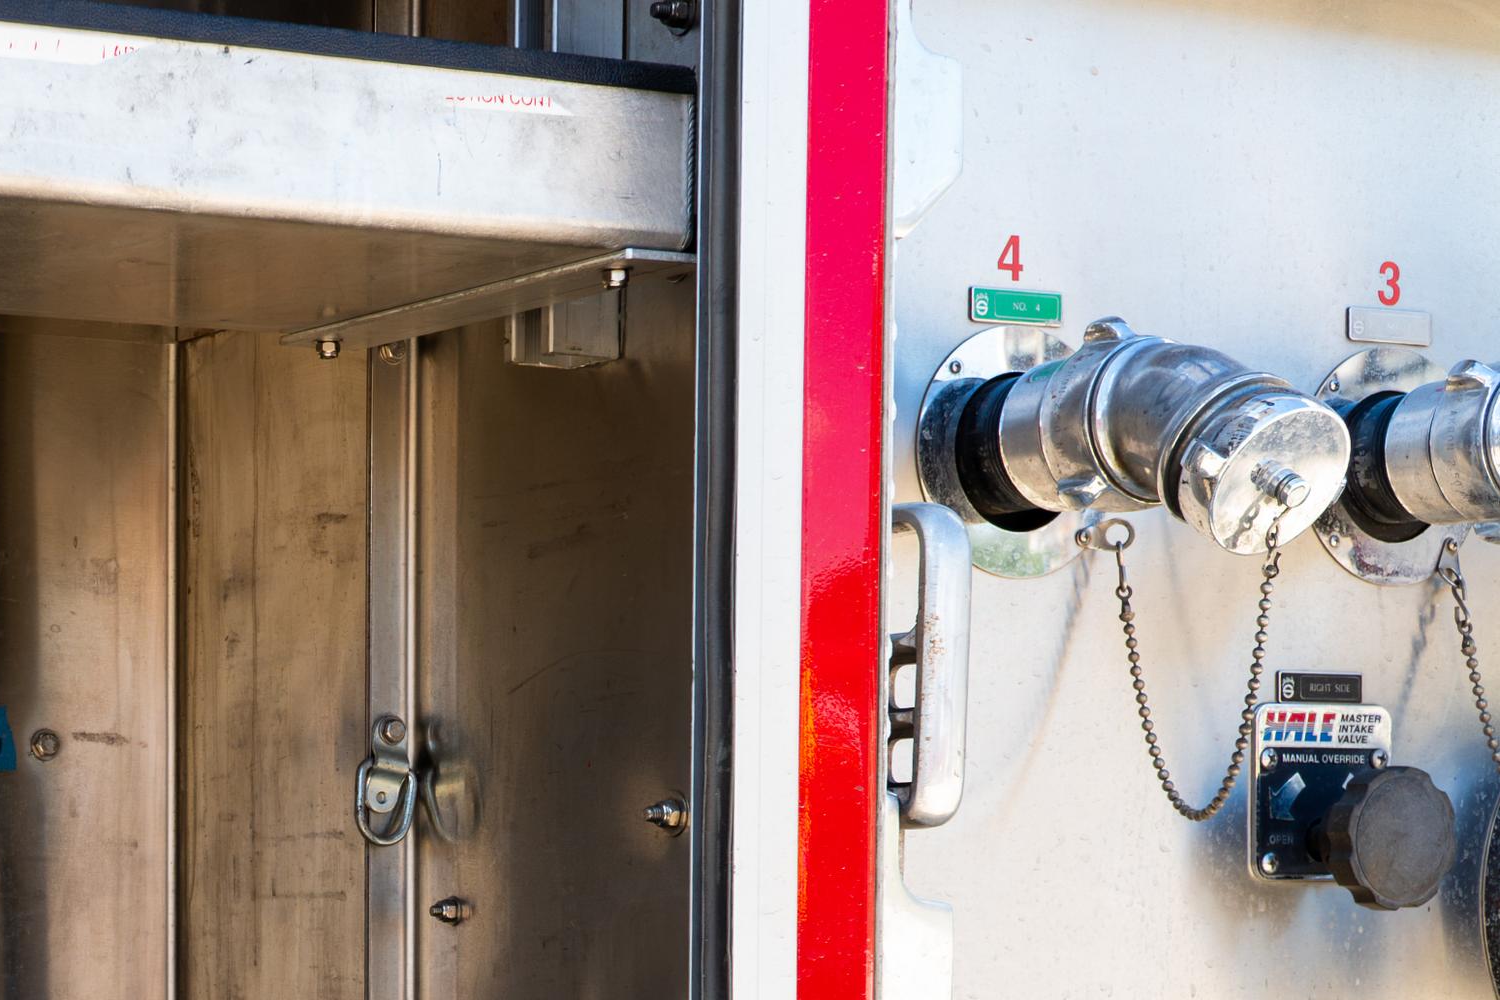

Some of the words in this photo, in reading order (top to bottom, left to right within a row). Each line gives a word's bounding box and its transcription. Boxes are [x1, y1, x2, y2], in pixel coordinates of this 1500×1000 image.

[997, 235, 1023, 281] 4
[1378, 261, 1400, 306] 3
[1035, 303, 1041, 312] 4
[1341, 714, 1381, 724] MASTER
[1263, 712, 1336, 742] HALE
[1339, 724, 1375, 734] INTAKE
[1338, 735, 1368, 744] VALVE
[1282, 754, 1319, 764] MANUAL
[1322, 754, 1365, 764] OVERRIDE
[1269, 833, 1294, 845] OPEN
